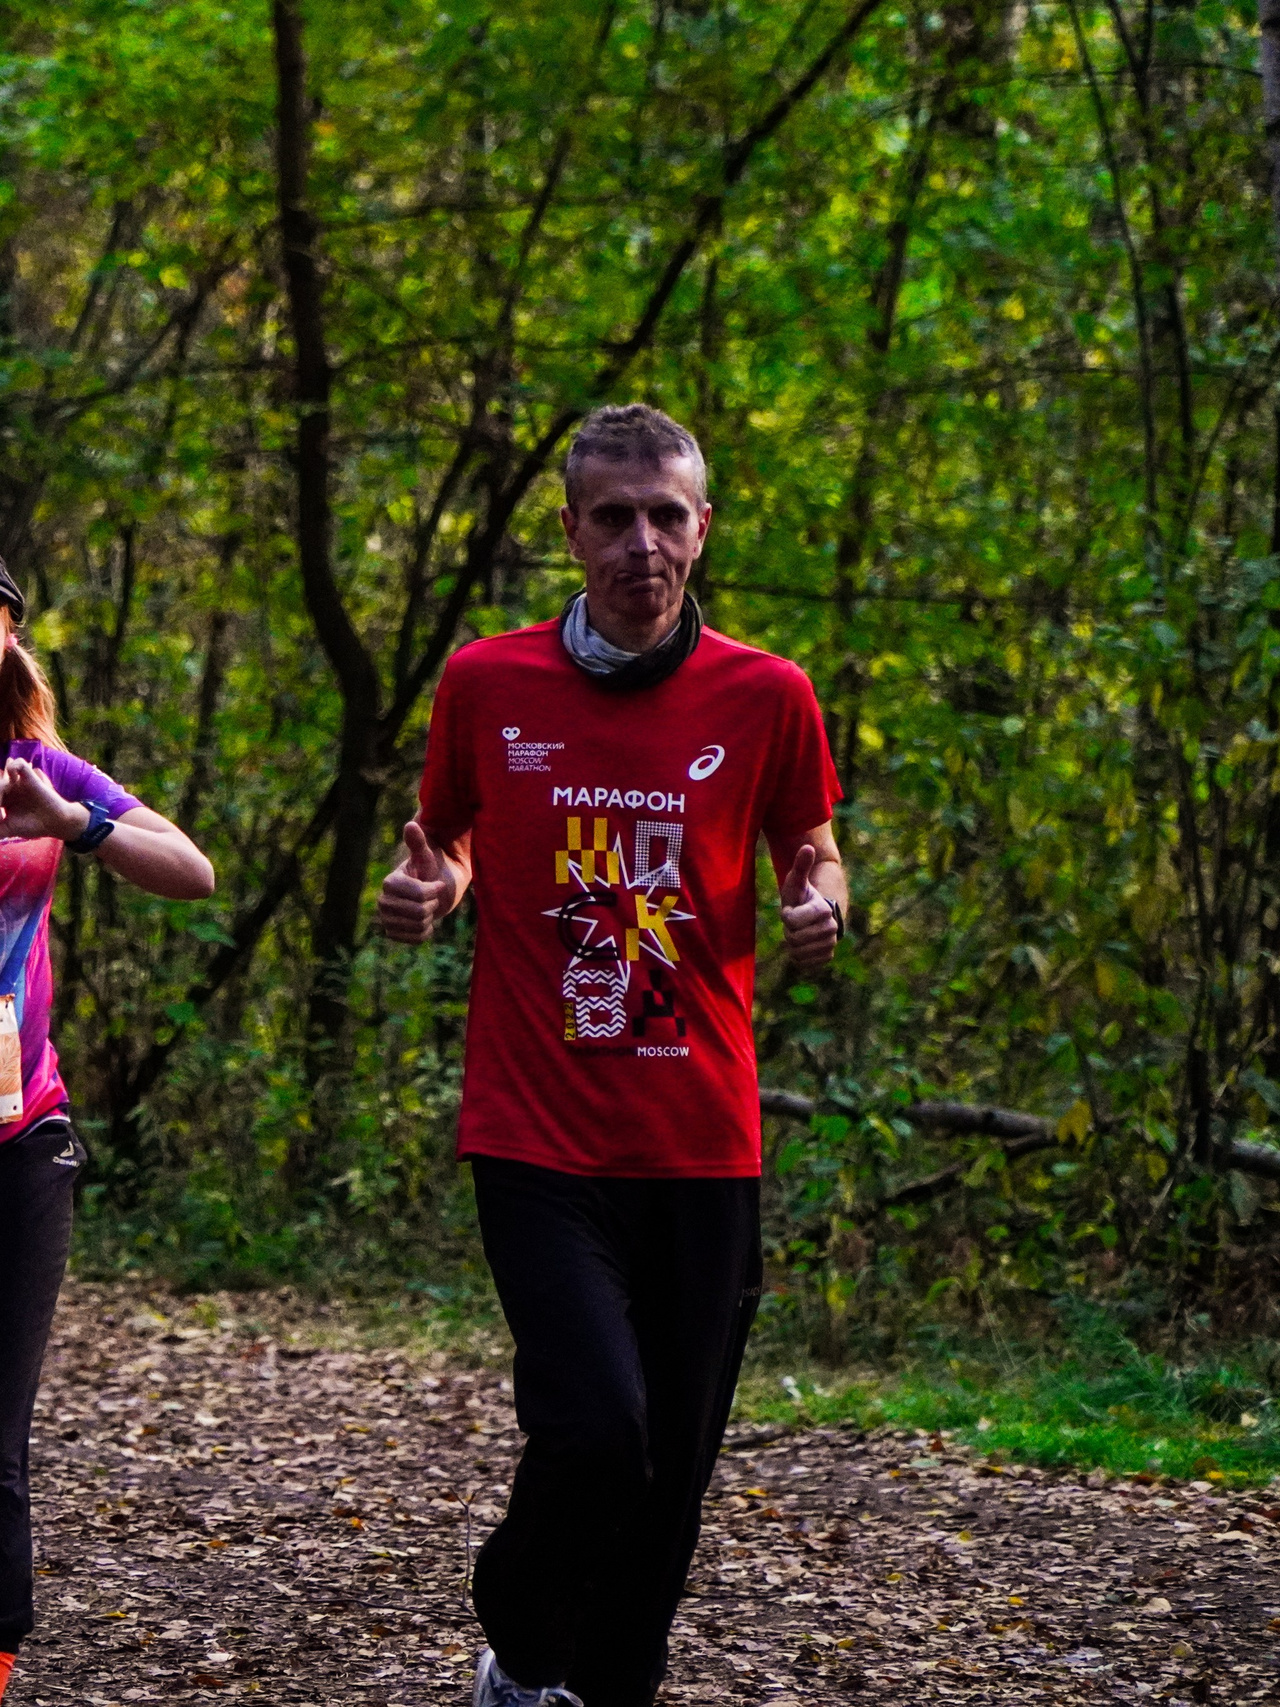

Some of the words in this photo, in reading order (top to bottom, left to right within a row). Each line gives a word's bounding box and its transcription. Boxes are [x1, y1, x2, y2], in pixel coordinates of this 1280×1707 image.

[508, 741, 565, 750] МОСКОВСКИЙ
[508, 764, 551, 772] MARATHON
[553, 786, 685, 813] МАРАФОН
[563, 1003, 575, 1039] 2022
[637, 1046, 690, 1057] MOSCOW
